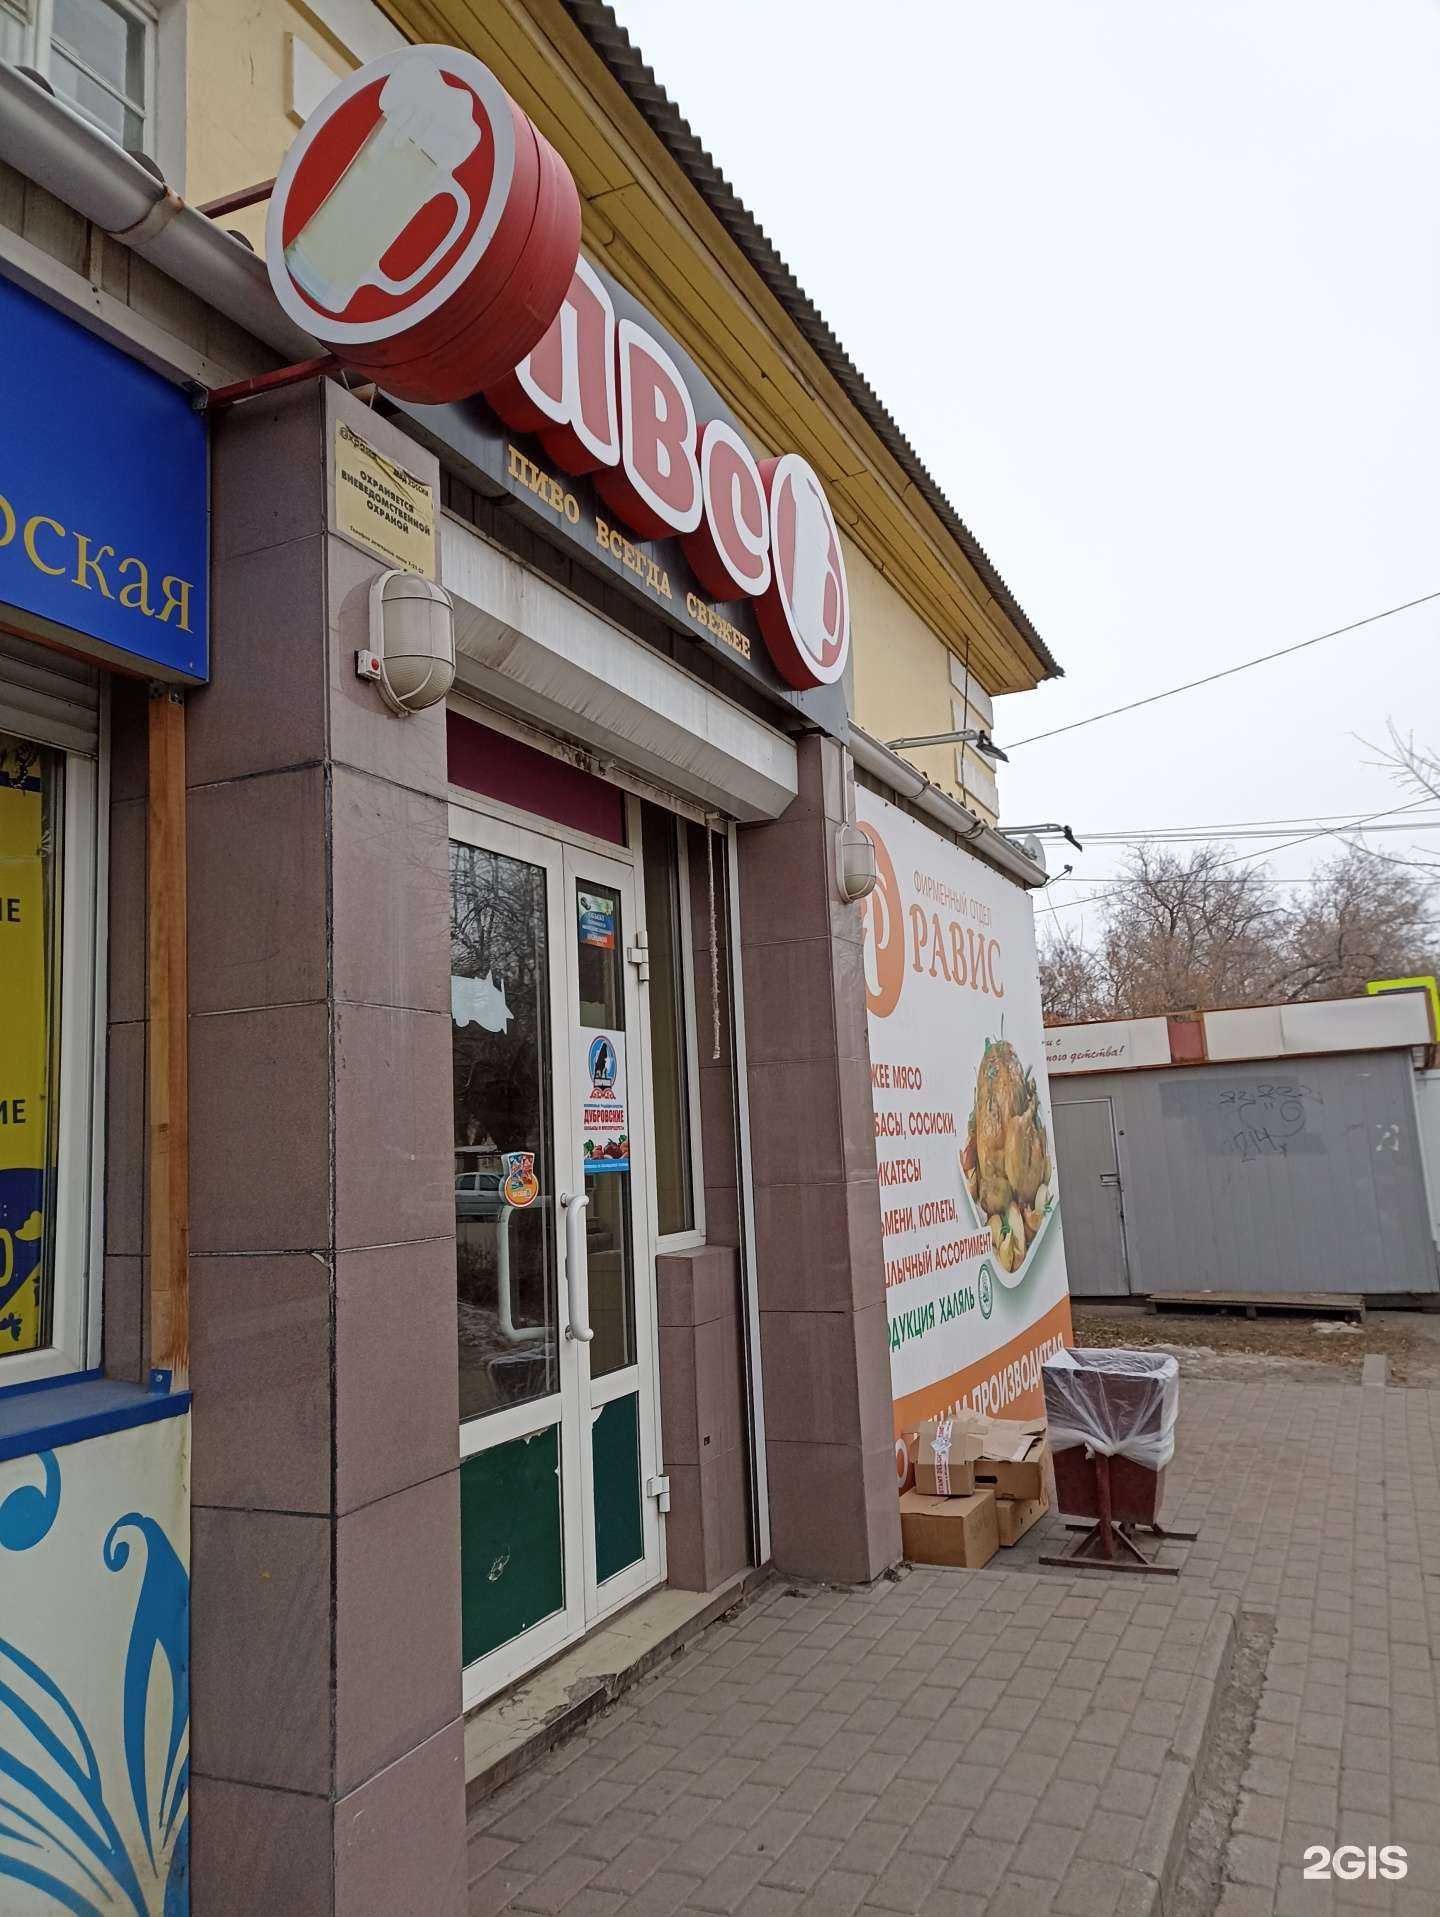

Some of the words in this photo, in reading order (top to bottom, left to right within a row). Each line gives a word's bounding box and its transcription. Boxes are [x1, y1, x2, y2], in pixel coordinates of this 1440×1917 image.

[341, 469, 431, 537] ВНЕВЕДОМСТВЕННОЙ
[366, 499, 410, 535] ОХРАНОЙ
[507, 444, 581, 525] ПИВО
[595, 516, 673, 600] ВСЕГДА
[686, 591, 751, 661] СВЕЖЕЕ
[913, 869, 968, 916] ФИРМЕННЫЙ
[969, 894, 993, 929] ОТДЕЛ
[909, 904, 1004, 998] РАВИС
[893, 1065, 922, 1090] МЯСО
[908, 1111, 957, 1137] СОСИСКИ,
[919, 1198, 959, 1228] КОТЛЕТЫ,
[935, 1231, 993, 1271] АССОРТИМЕНТ
[888, 1301, 936, 1353] ДУКЦИЯ
[938, 1285, 976, 1325] ХАЛЯЛЬ
